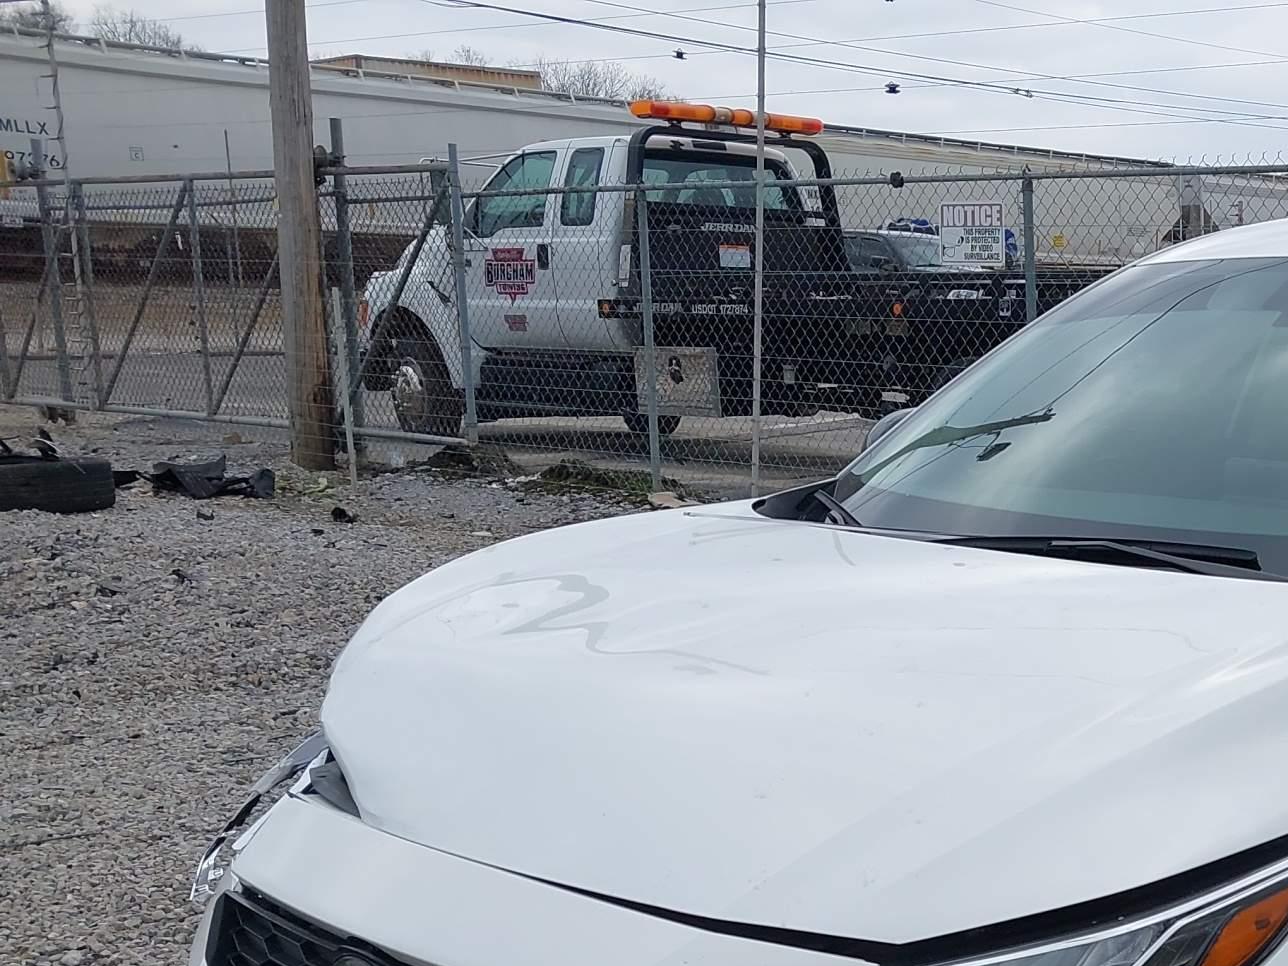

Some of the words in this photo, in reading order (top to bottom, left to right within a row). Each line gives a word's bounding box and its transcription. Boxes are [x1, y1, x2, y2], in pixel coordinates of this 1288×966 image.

[0, 118, 48, 135] MLLX
[942, 205, 1001, 227] NOTICE
[963, 228, 973, 236] THIS
[975, 228, 1000, 236] PROPERTY
[965, 236, 970, 244] IS
[971, 236, 999, 244] PROTECTED
[970, 244, 977, 252] BY
[978, 244, 993, 252] VIDEO
[964, 252, 1000, 260] SURVEILLANCE
[486, 262, 533, 284] BURGHAM
[691, 303, 716, 314] USDOT
